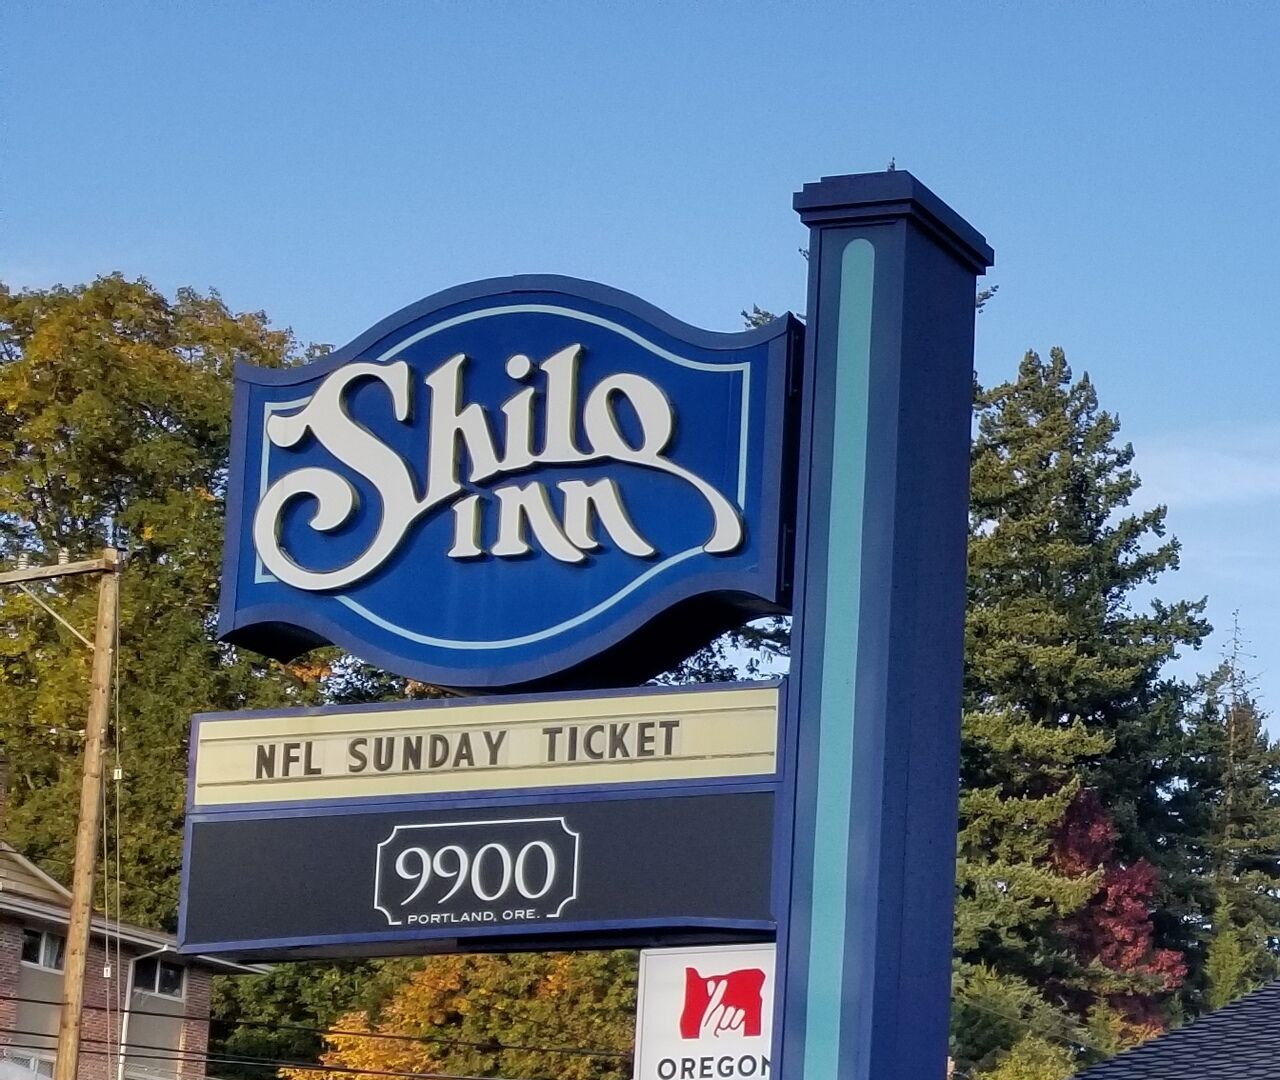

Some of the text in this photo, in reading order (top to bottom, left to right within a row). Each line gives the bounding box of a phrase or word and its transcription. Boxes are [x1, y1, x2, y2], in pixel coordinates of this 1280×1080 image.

[253, 343, 743, 590] Shilo
[255, 720, 680, 779] NFL SUNDAY TICKET
[395, 840, 556, 906] 9900
[407, 909, 541, 925] PORTLAND, ORE.
